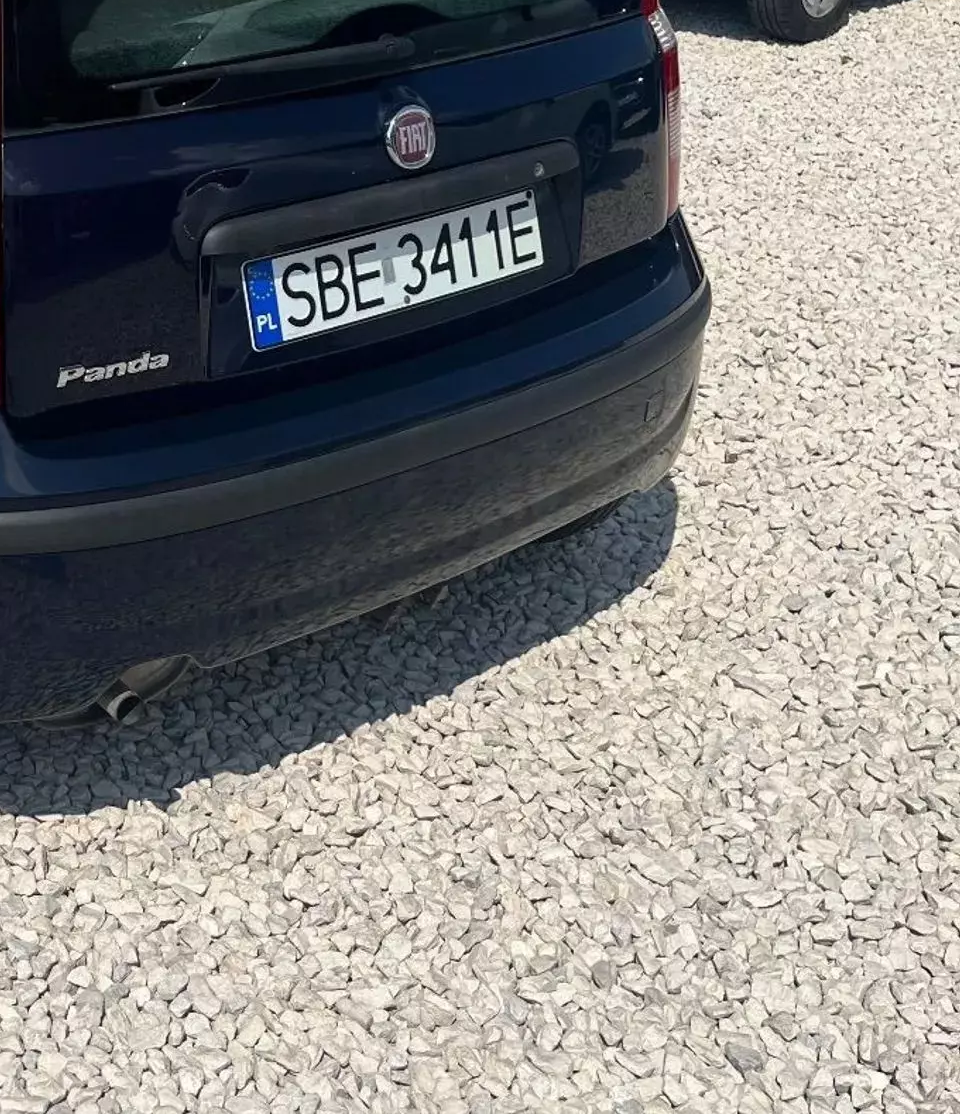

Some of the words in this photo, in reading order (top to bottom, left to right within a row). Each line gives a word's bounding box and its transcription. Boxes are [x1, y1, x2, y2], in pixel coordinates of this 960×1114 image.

[398, 121, 428, 155] FIAT
[281, 242, 385, 328] SBE
[397, 199, 537, 296] 3411E
[256, 313, 278, 333] PL
[55, 350, 170, 388] Panda
